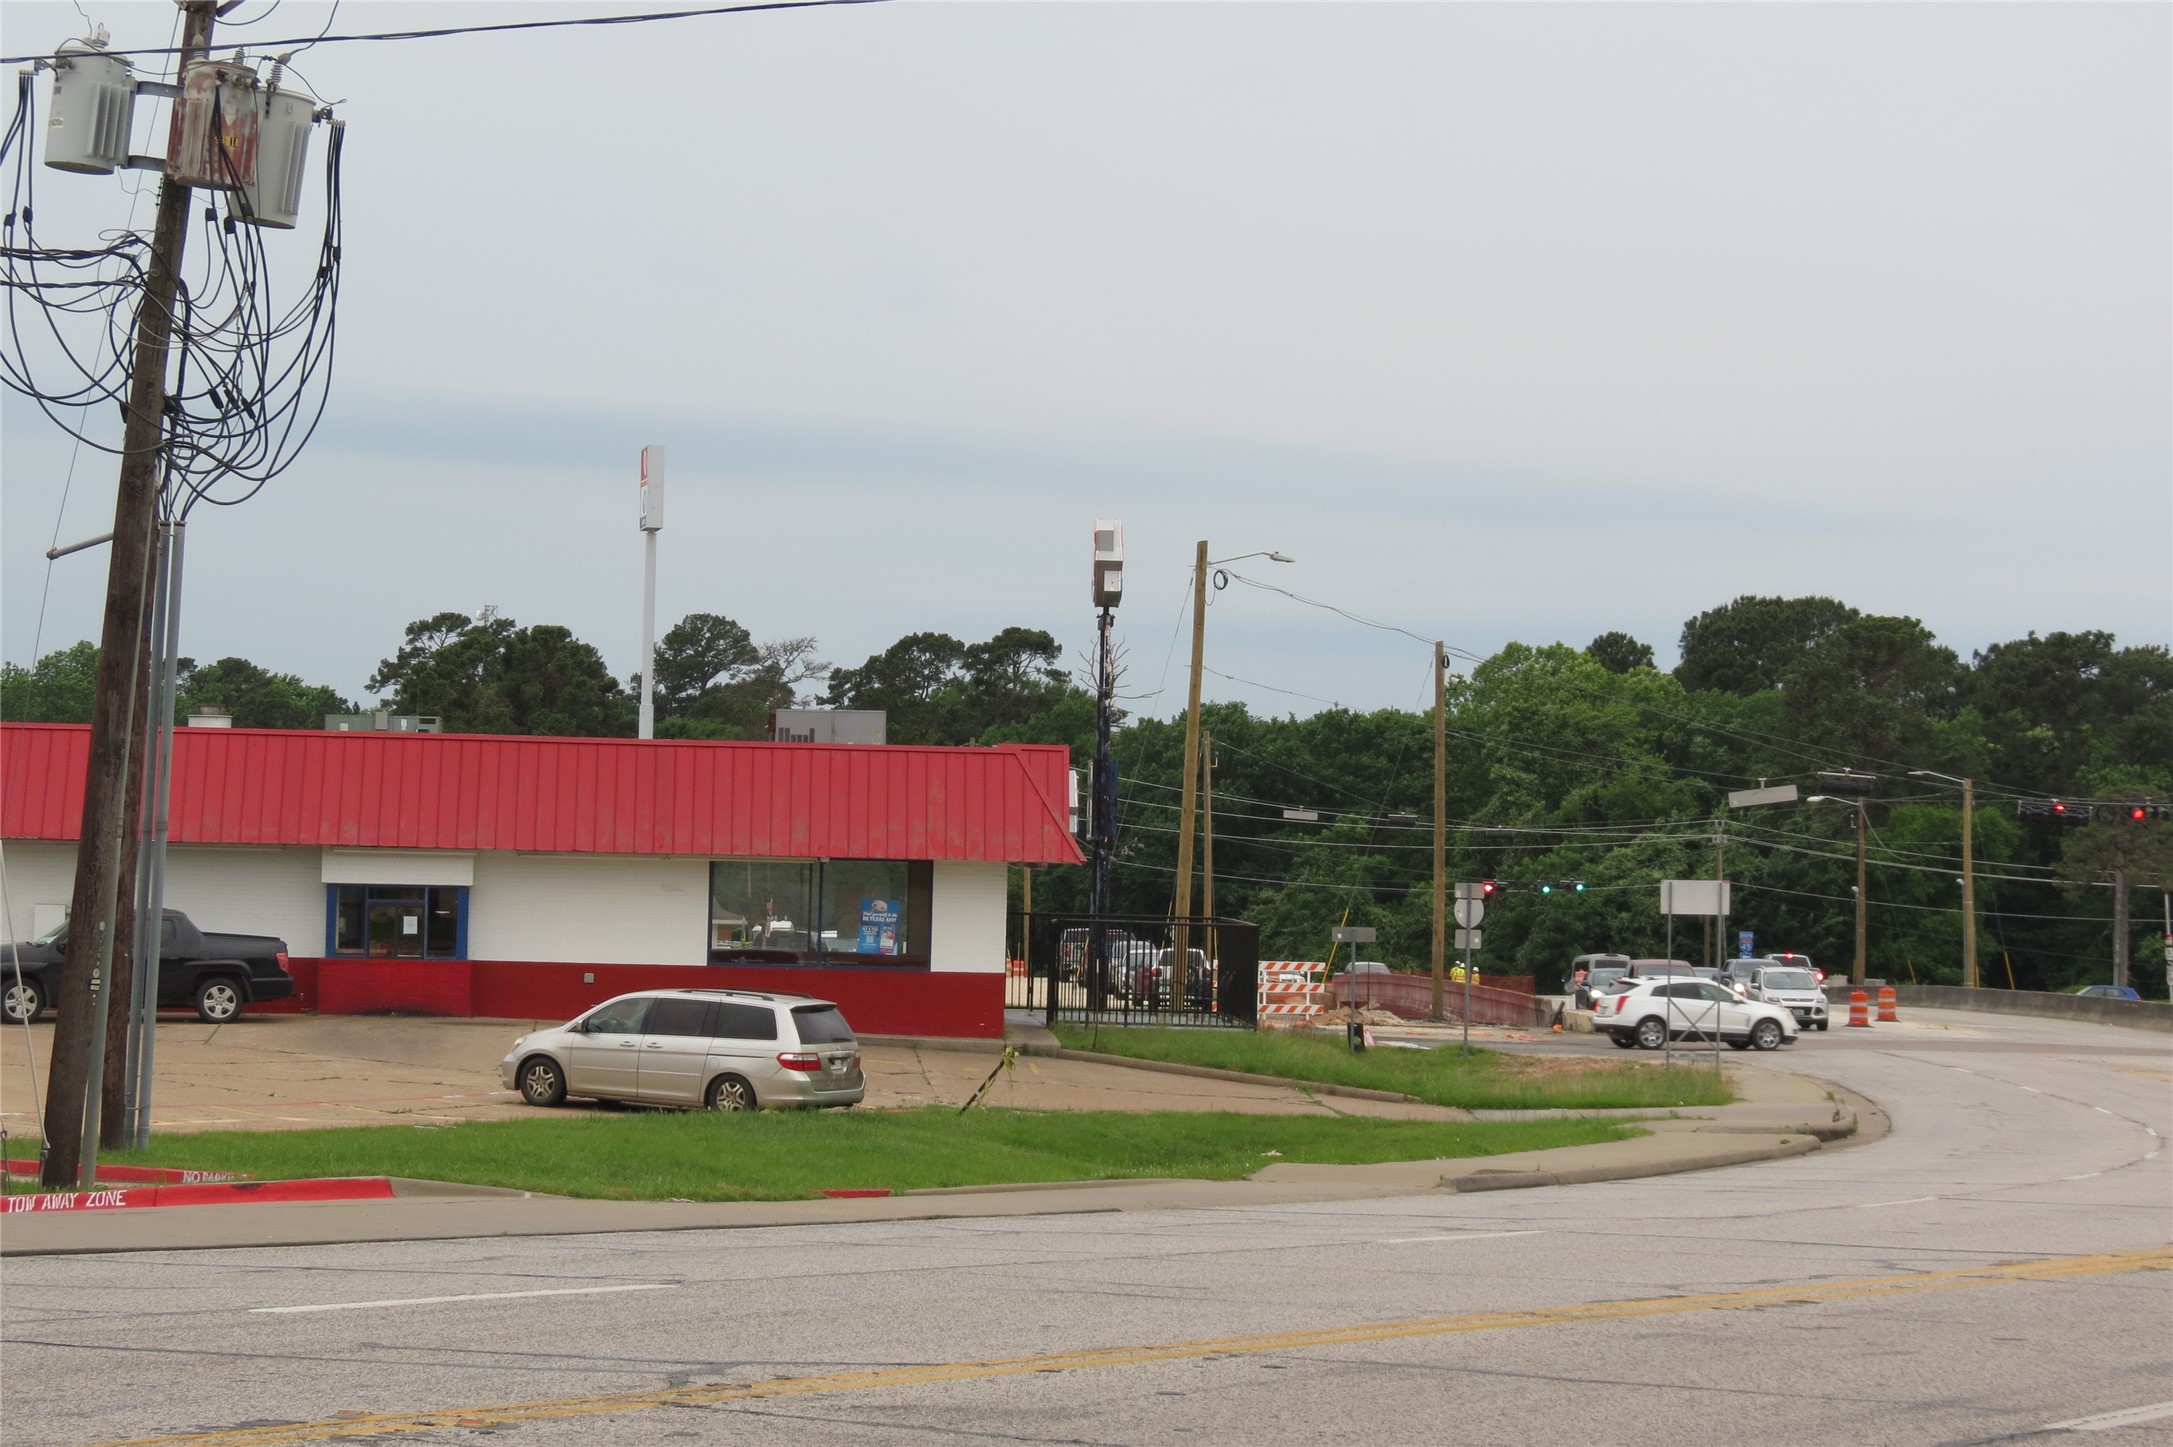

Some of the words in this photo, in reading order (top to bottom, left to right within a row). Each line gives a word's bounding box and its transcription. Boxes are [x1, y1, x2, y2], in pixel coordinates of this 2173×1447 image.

[183, 1170, 200, 1183] NO
[8, 1195, 36, 1213] TOW
[41, 1192, 79, 1210] AWAY
[86, 1189, 127, 1207] ZONE
